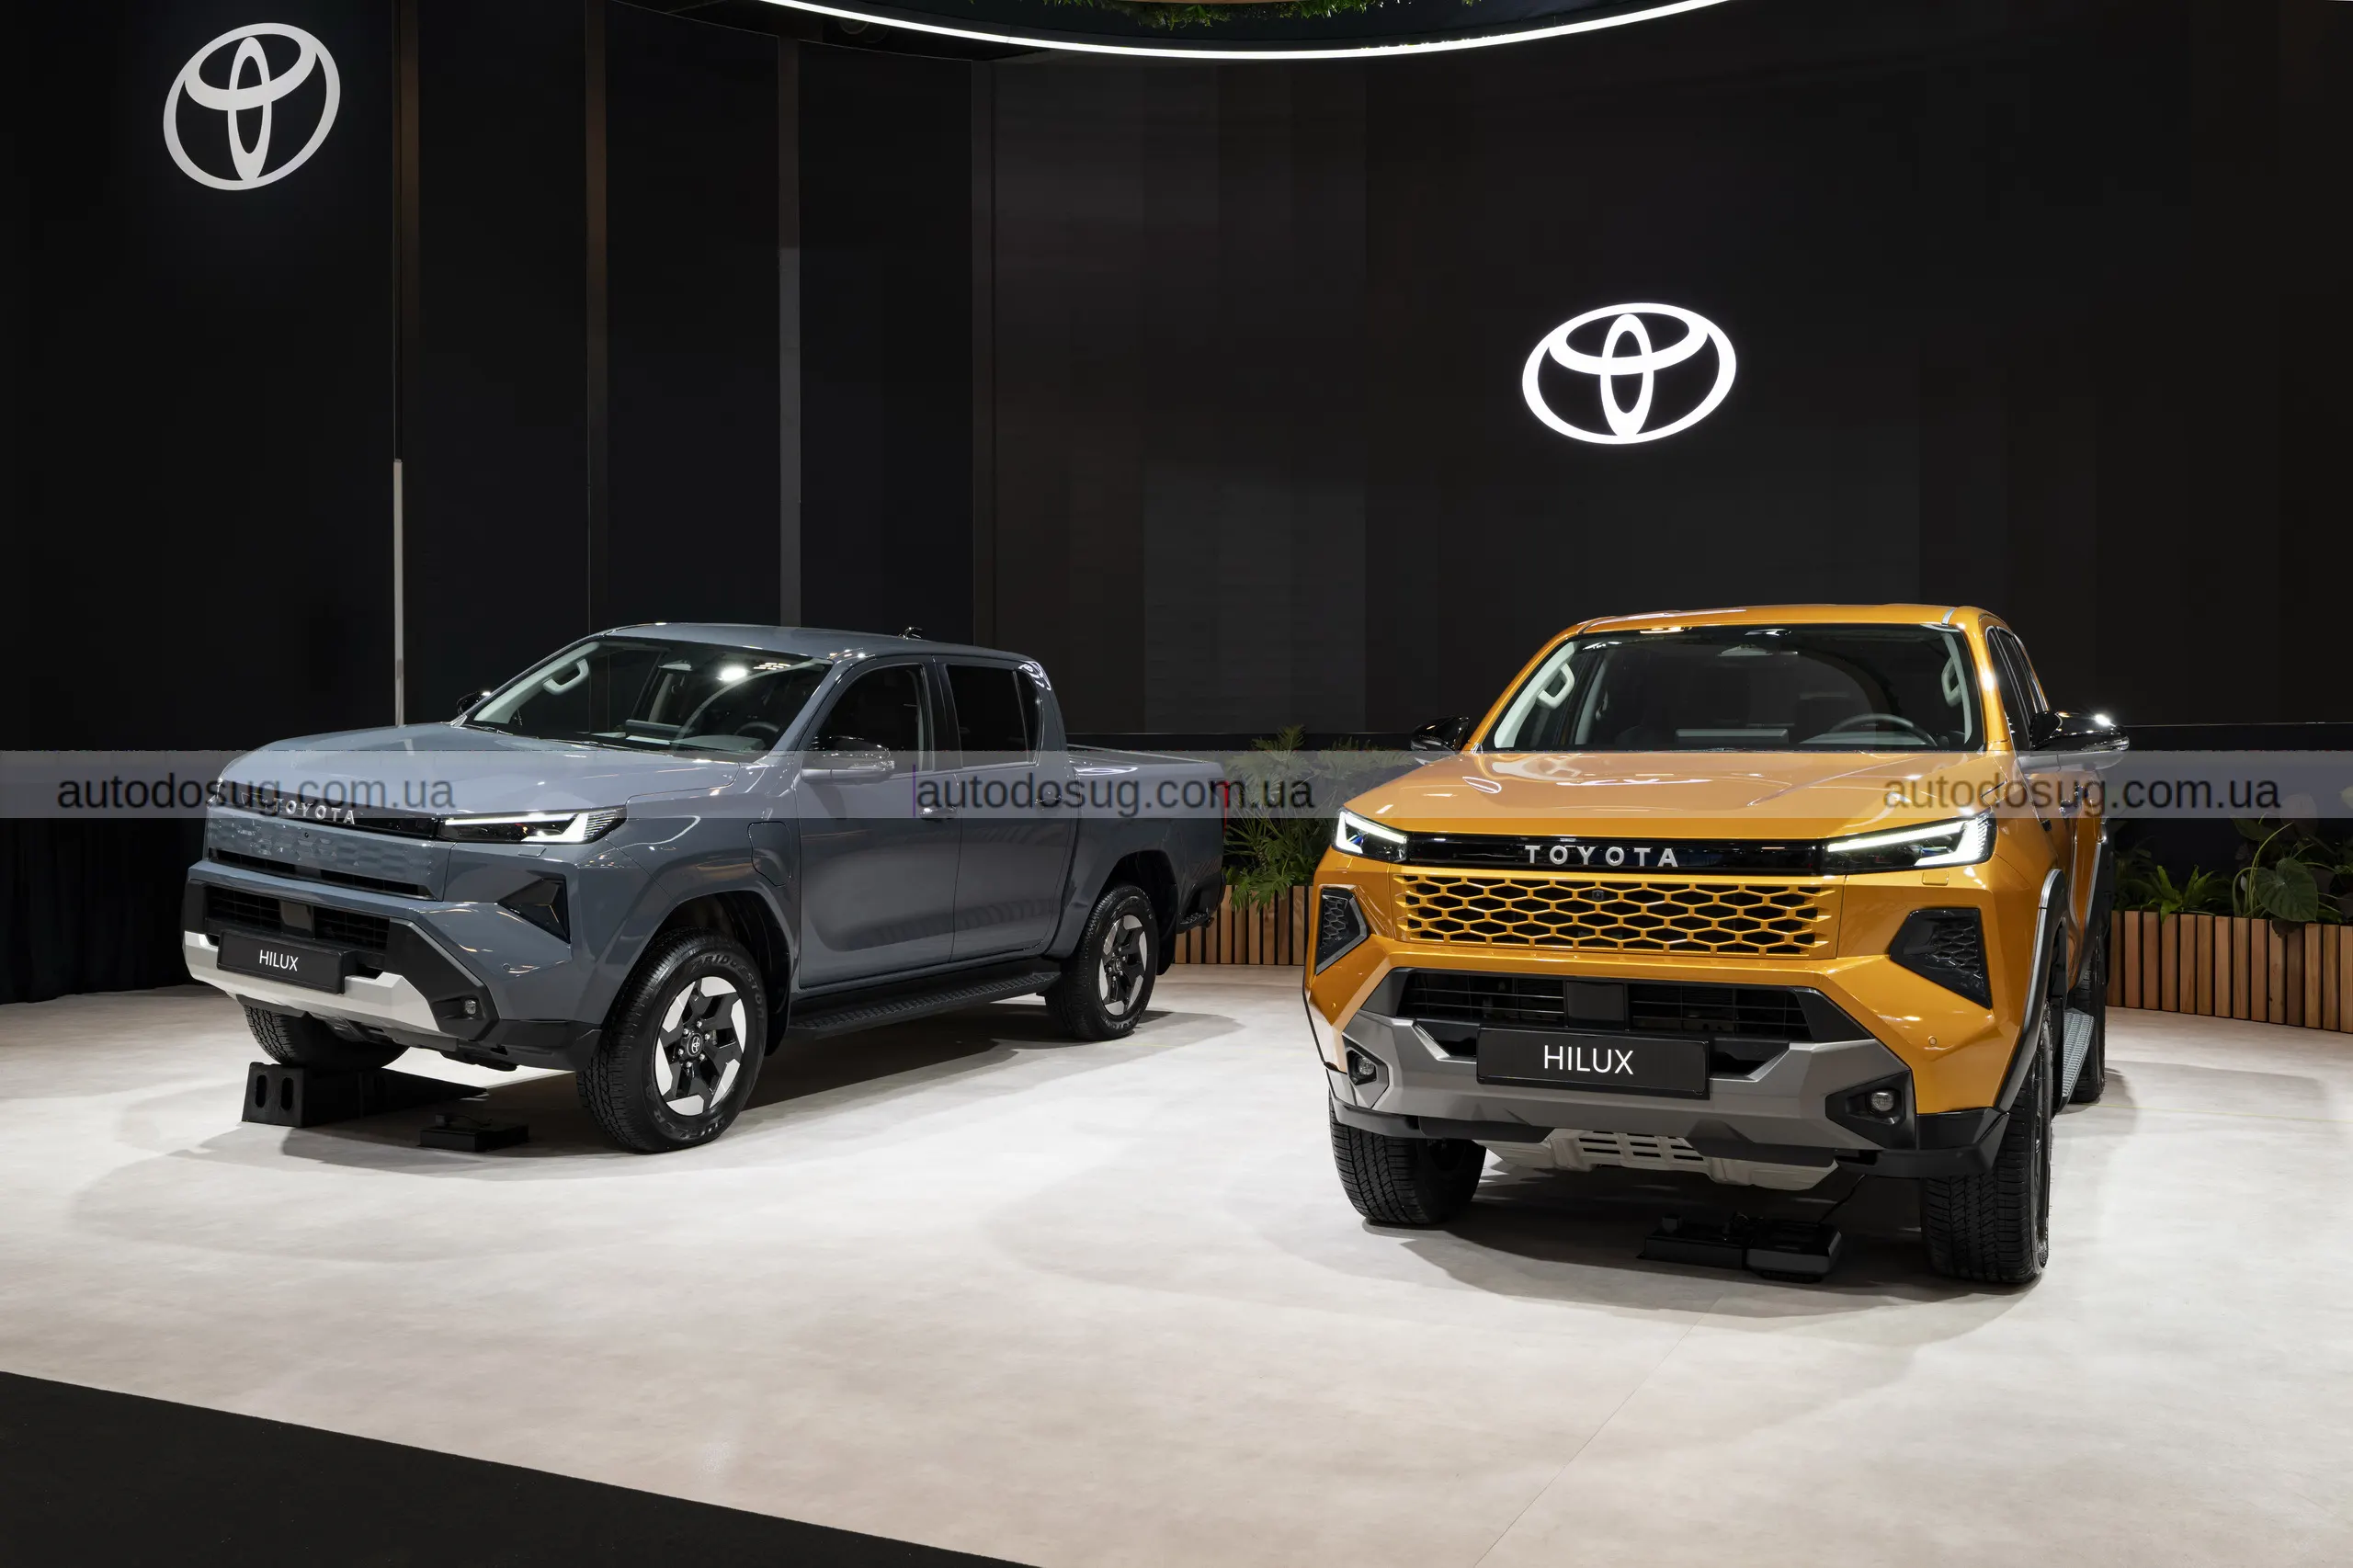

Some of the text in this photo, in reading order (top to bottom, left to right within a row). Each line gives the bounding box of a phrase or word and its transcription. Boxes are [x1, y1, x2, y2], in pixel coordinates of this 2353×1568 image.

[274, 798, 356, 825] TOYOTA
[1526, 845, 1678, 868] TOYOTA
[259, 949, 298, 971] HILUX
[690, 953, 765, 1028] BRIDGESTON
[1544, 1044, 1634, 1075] HILUX
